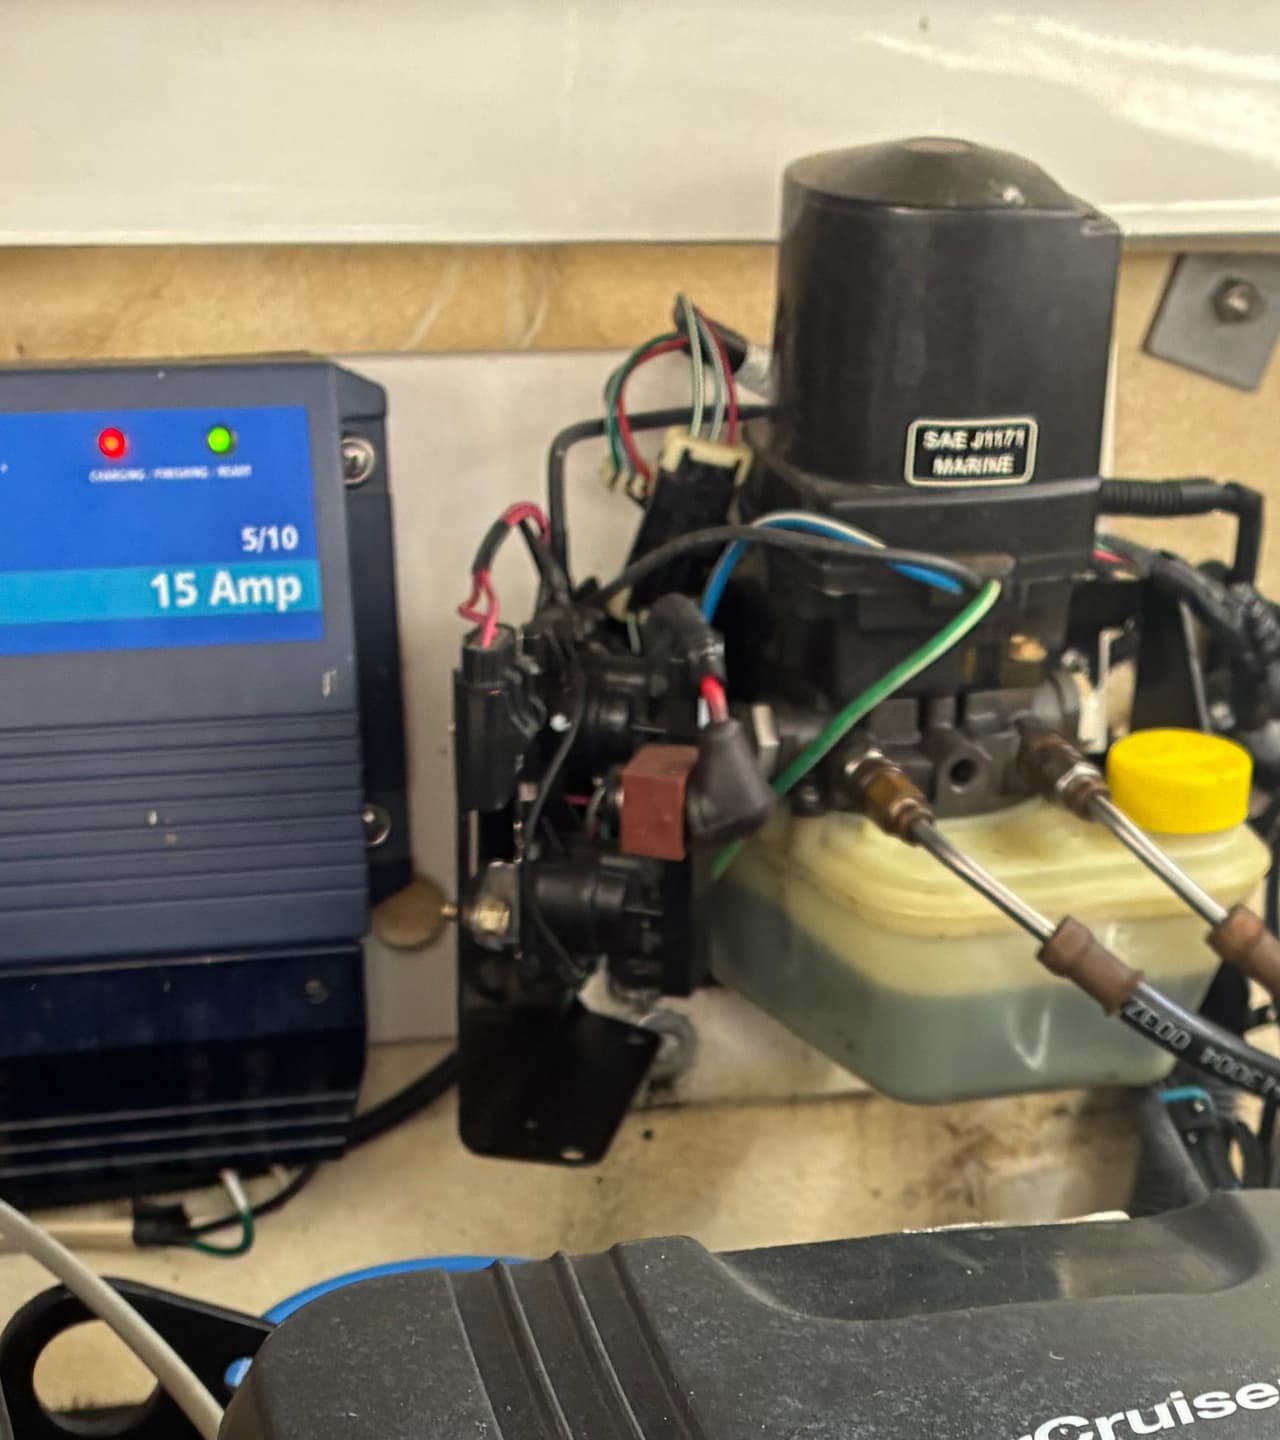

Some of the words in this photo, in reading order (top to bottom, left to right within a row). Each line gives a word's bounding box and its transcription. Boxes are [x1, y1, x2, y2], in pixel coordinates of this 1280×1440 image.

[922, 430, 968, 450] SAE
[932, 453, 1015, 475] MARINE
[240, 524, 299, 553] 5/10
[150, 570, 199, 608] 15
[209, 568, 303, 613] Amp
